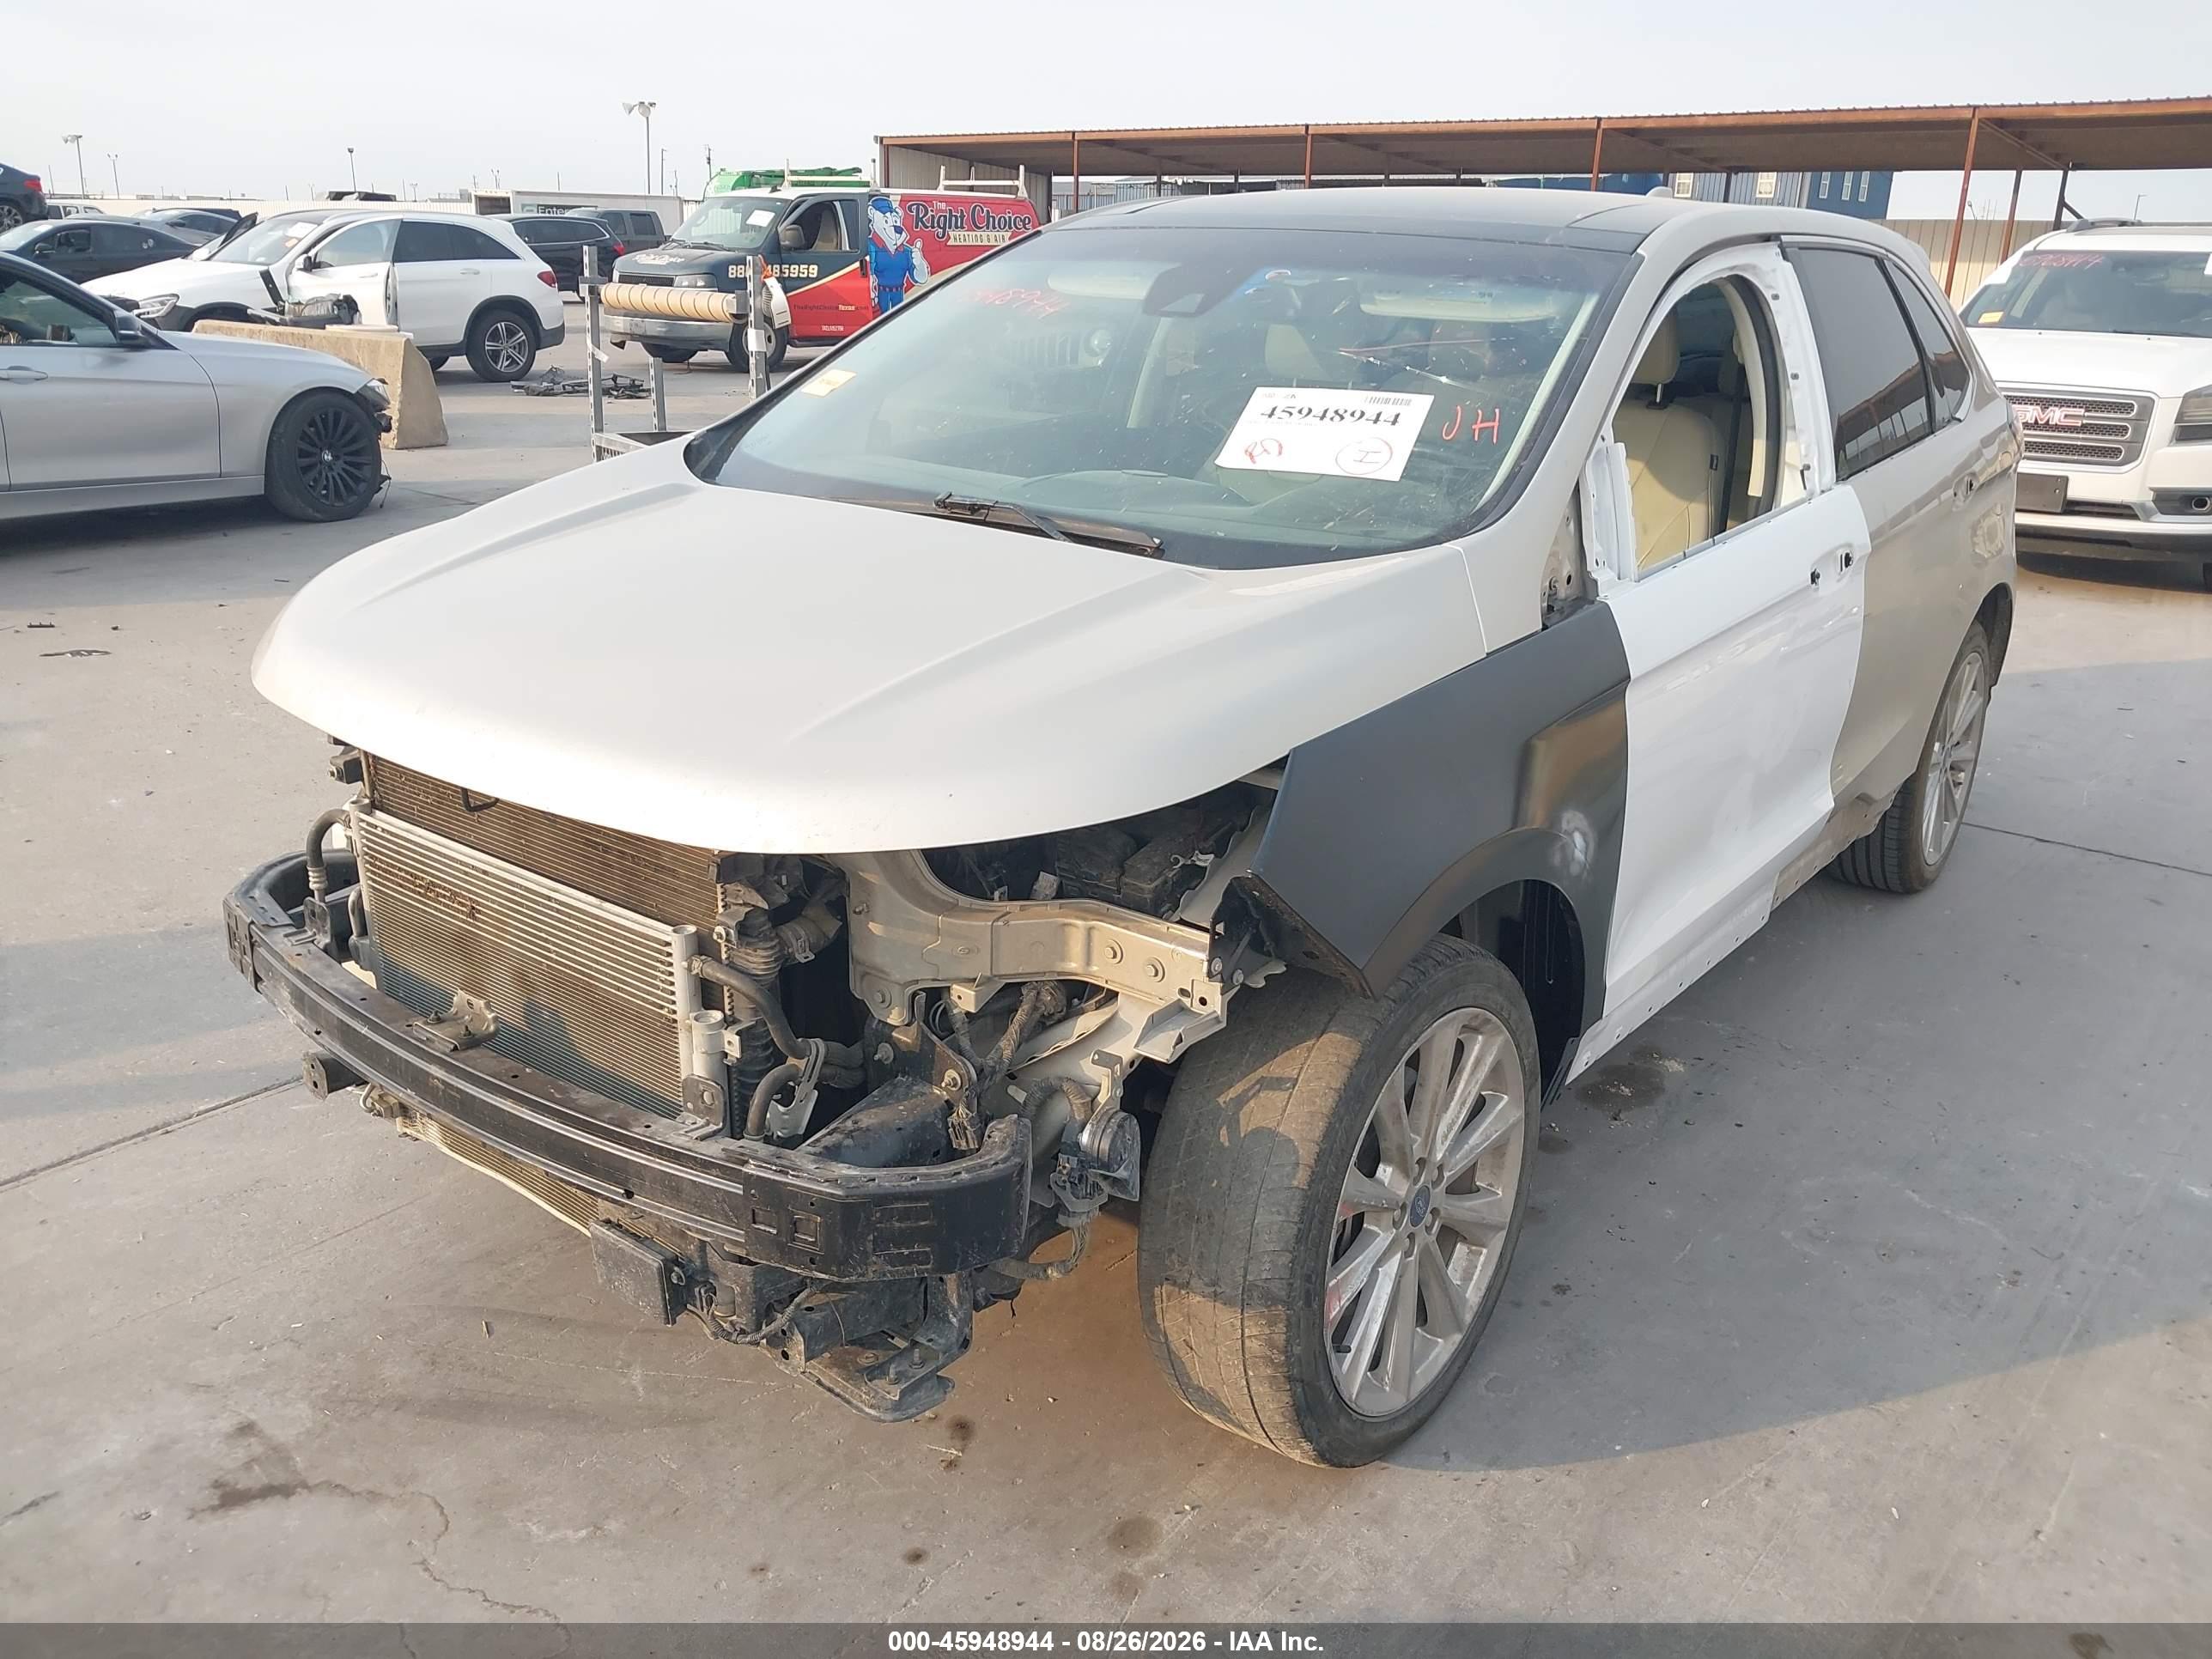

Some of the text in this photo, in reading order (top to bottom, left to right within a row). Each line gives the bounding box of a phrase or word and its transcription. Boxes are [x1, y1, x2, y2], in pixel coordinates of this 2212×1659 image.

[933, 201, 946, 210] The
[907, 202, 1032, 240] Right Choice
[994, 234, 1006, 243] AIR
[1261, 405, 1401, 426] 45948944
[2012, 404, 2085, 427] GMC
